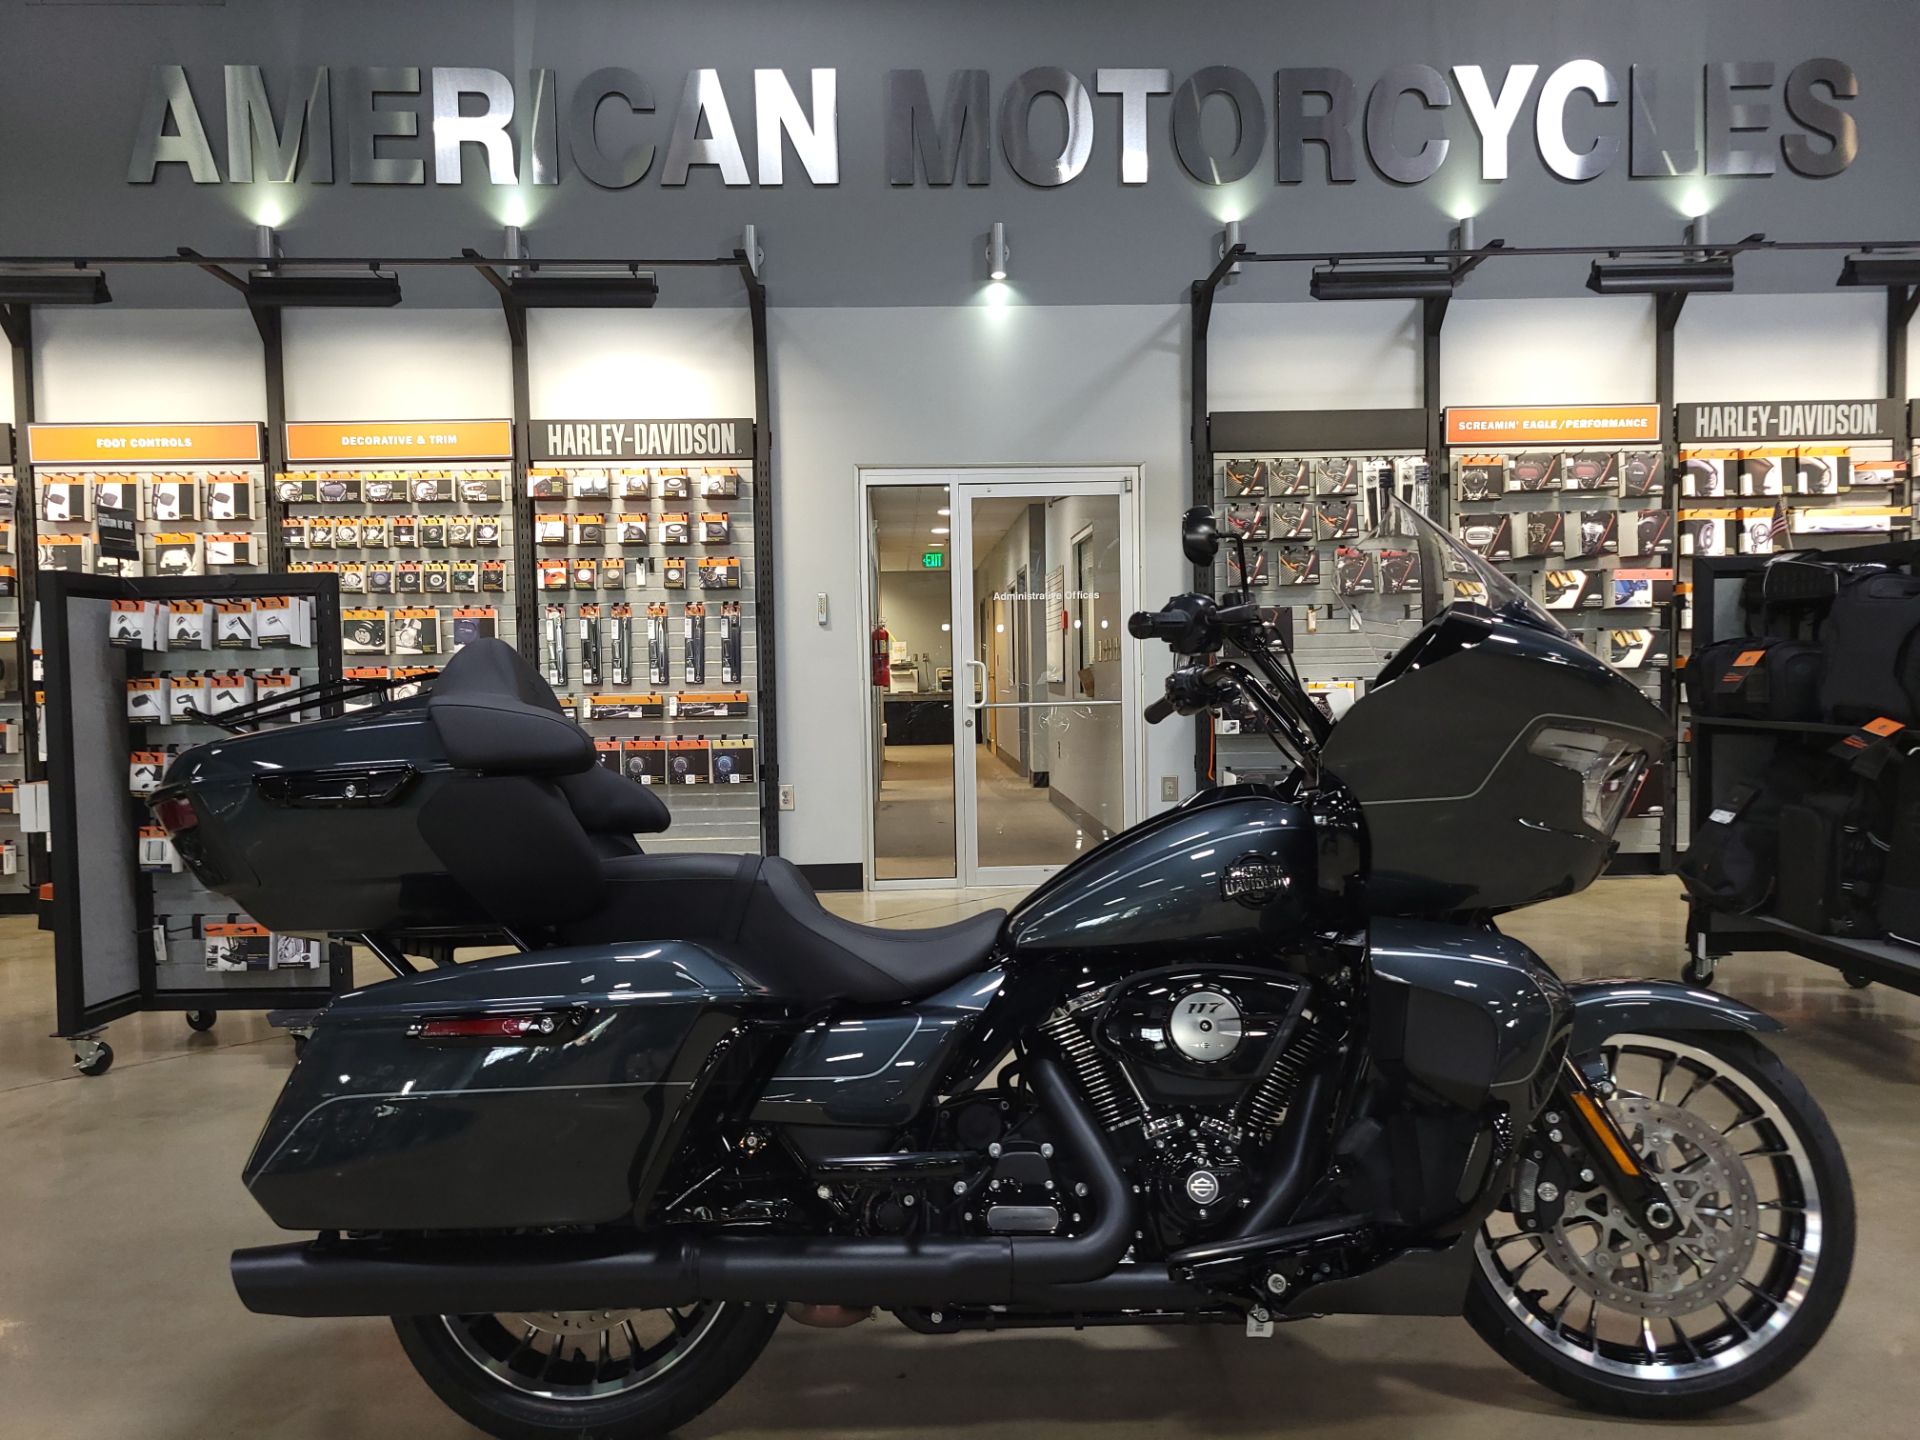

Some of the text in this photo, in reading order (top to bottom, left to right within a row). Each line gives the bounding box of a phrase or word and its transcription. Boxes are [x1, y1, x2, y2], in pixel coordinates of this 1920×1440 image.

[127, 57, 1859, 187] AMERICAN MOTORCYCLES
[1458, 420, 1519, 431] SCREAMIN'
[1695, 403, 1878, 438] HARLEY-DAVIDSON
[96, 437, 192, 448] FOOT CONTROLS
[341, 435, 457, 446] DECORATIVE & TRIM
[547, 422, 735, 456] HARLEY-DAVIDSON
[925, 553, 943, 567] EXIT
[993, 590, 1100, 601] Administrative Offices
[1187, 1002, 1224, 1015] 117
